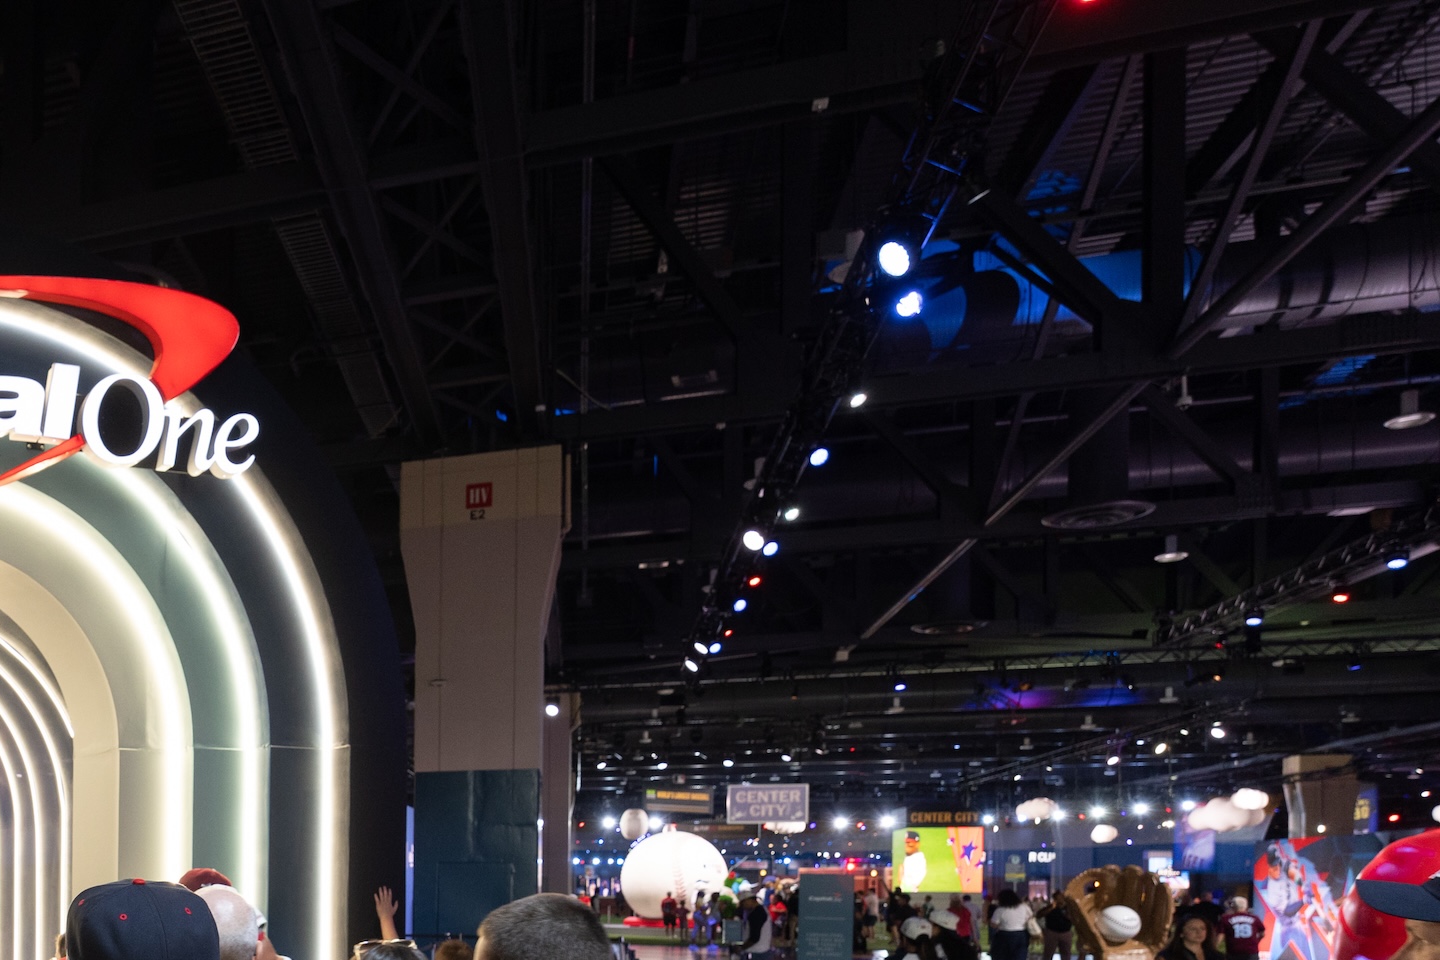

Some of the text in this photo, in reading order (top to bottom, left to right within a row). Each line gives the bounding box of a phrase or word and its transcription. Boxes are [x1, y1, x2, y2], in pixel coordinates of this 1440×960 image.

[80, 373, 260, 479] One
[735, 789, 801, 803] CENTER
[749, 804, 787, 818] CITY
[910, 811, 980, 823] CENTER CITY
